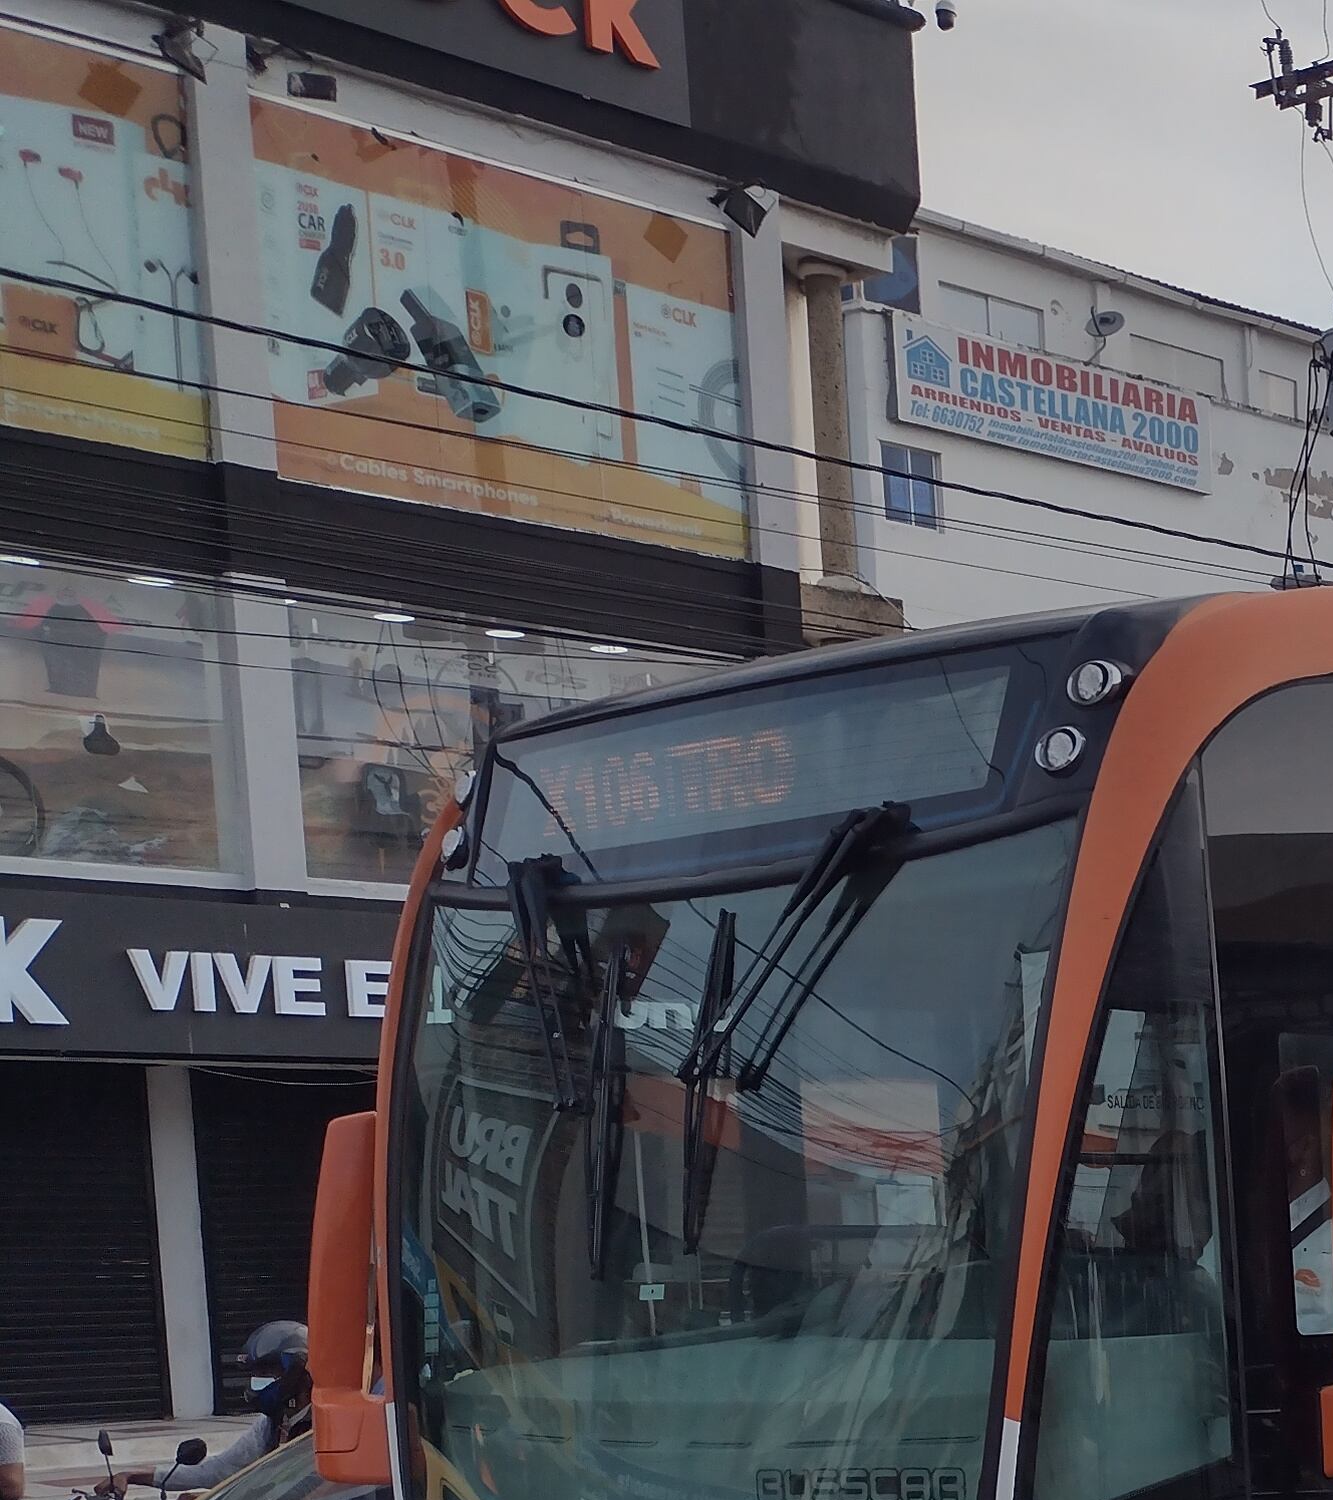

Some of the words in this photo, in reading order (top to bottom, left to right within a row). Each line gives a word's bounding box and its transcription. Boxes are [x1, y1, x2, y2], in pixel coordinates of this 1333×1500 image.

[77, 125, 109, 139] NEW
[298, 212, 326, 233] CAR
[380, 248, 406, 271] 3.0
[672, 307, 697, 328] CLK
[957, 336, 1199, 425] INMOBILIARIA
[910, 400, 930, 419] Tel:
[931, 405, 985, 434] 6630752
[910, 384, 1021, 422] ARRIENDOS
[1038, 416, 1107, 443] VENTAS
[1121, 437, 1199, 467] AVALUOS
[960, 367, 1127, 436] CASTELLANA
[1132, 412, 1199, 454] 2000
[340, 453, 408, 484] Cables
[412, 468, 540, 507] Smartphones
[126, 947, 327, 1017] VIVE
